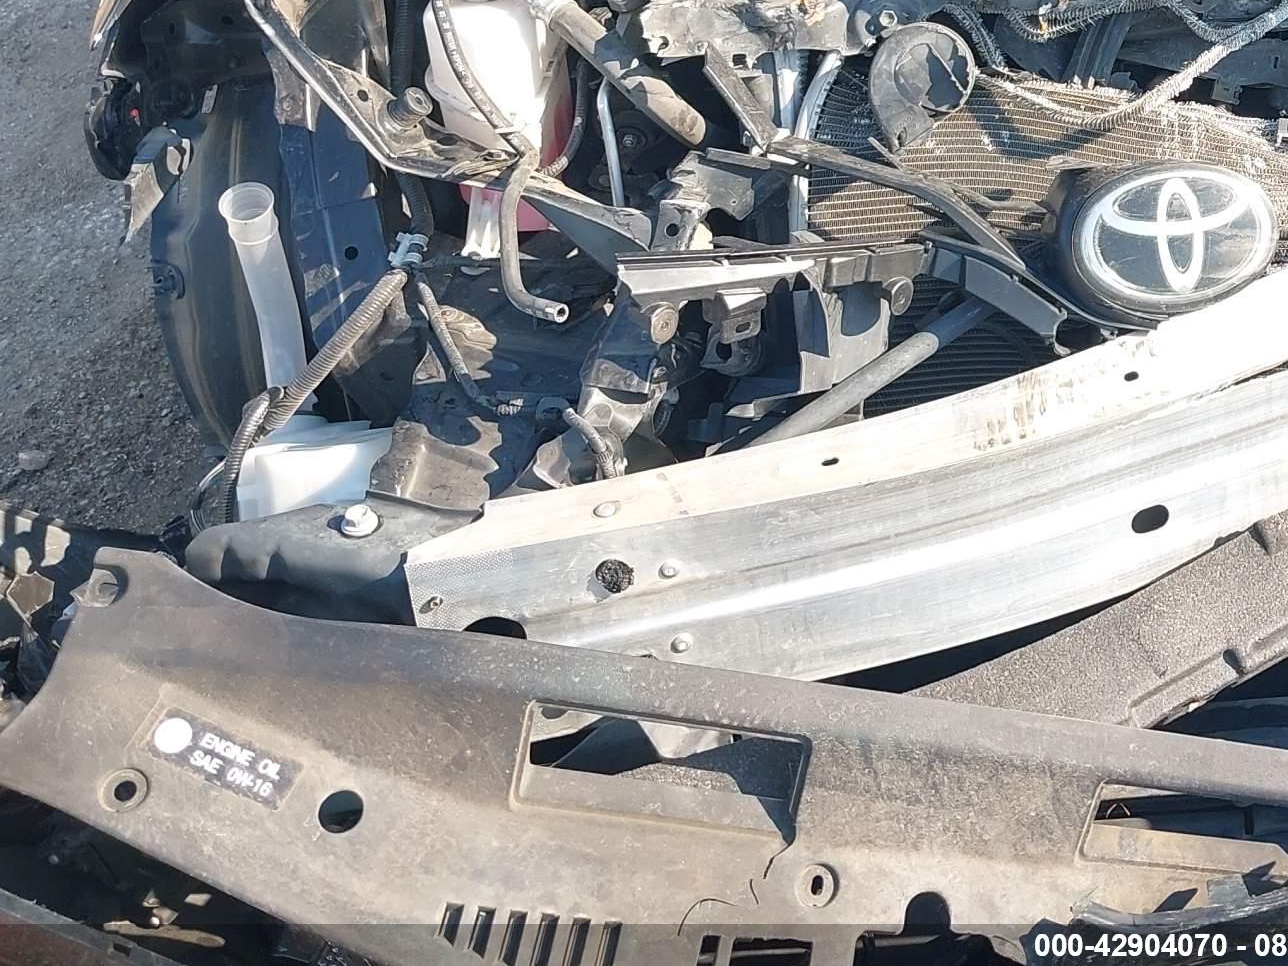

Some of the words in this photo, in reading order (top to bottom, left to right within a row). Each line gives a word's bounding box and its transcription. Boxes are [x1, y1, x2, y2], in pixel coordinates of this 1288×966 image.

[190, 750, 223, 774] SAE
[227, 769, 272, 797] 0W-16
[200, 732, 255, 766] ENGINE
[257, 758, 281, 780] OIL
